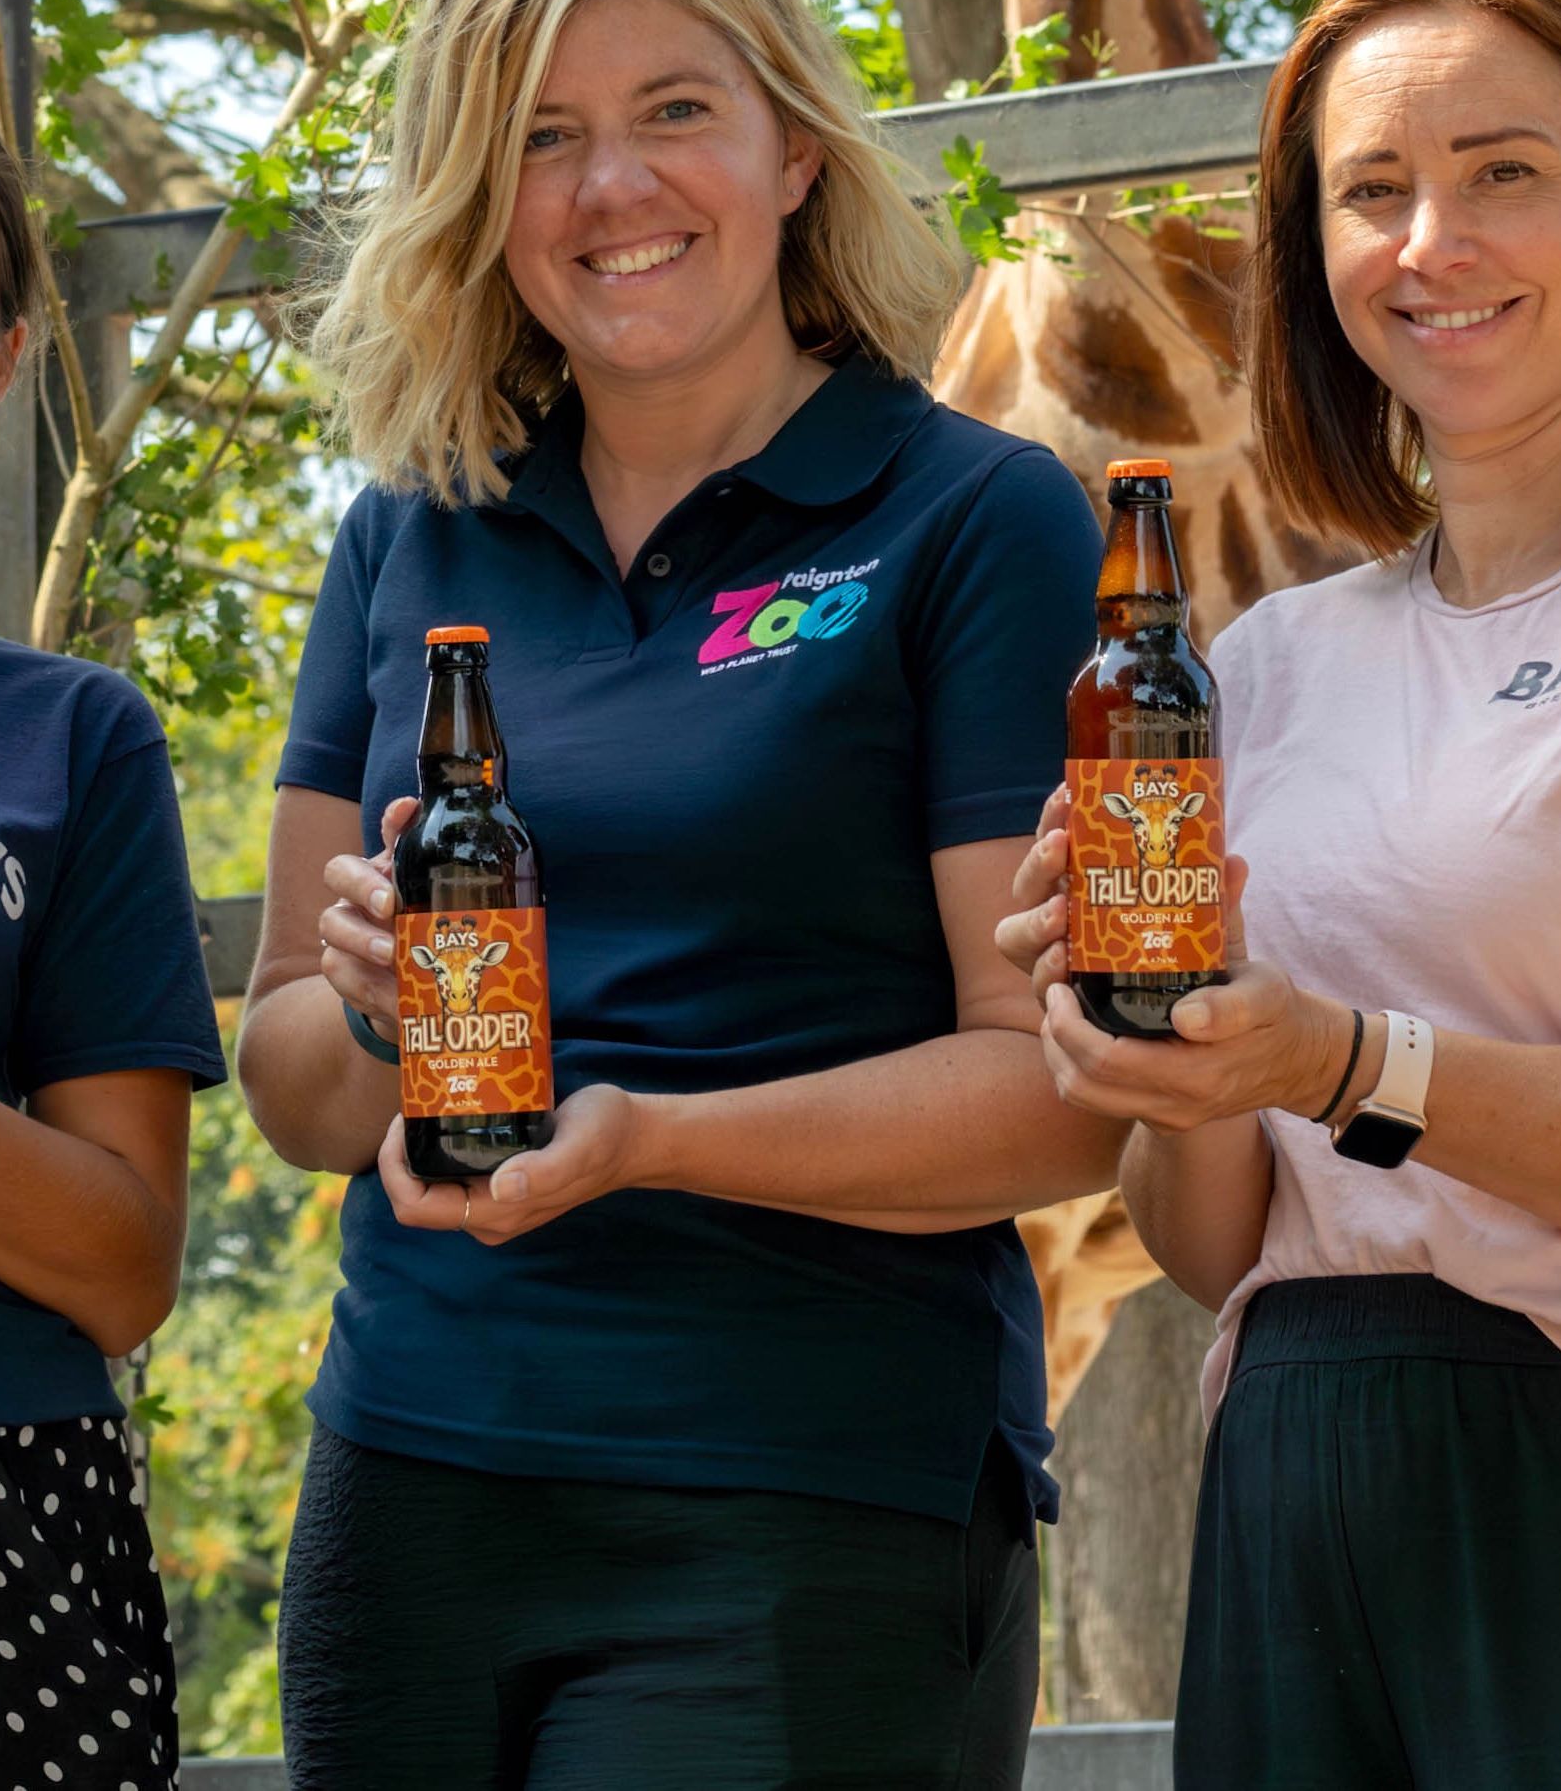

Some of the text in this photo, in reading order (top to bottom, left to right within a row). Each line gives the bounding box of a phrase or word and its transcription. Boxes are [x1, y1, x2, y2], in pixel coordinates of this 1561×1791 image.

[726, 652, 766, 669] PLANET
[767, 643, 799, 658] TRUST
[1133, 781, 1179, 799] BAYS
[1087, 867, 1220, 906] TALL ORDER
[1120, 912, 1193, 924] GOLDEN ALE
[434, 931, 479, 950] BAYS
[403, 1012, 531, 1054] TALL ORDER
[427, 1056, 499, 1070] GOLDEN ALE
